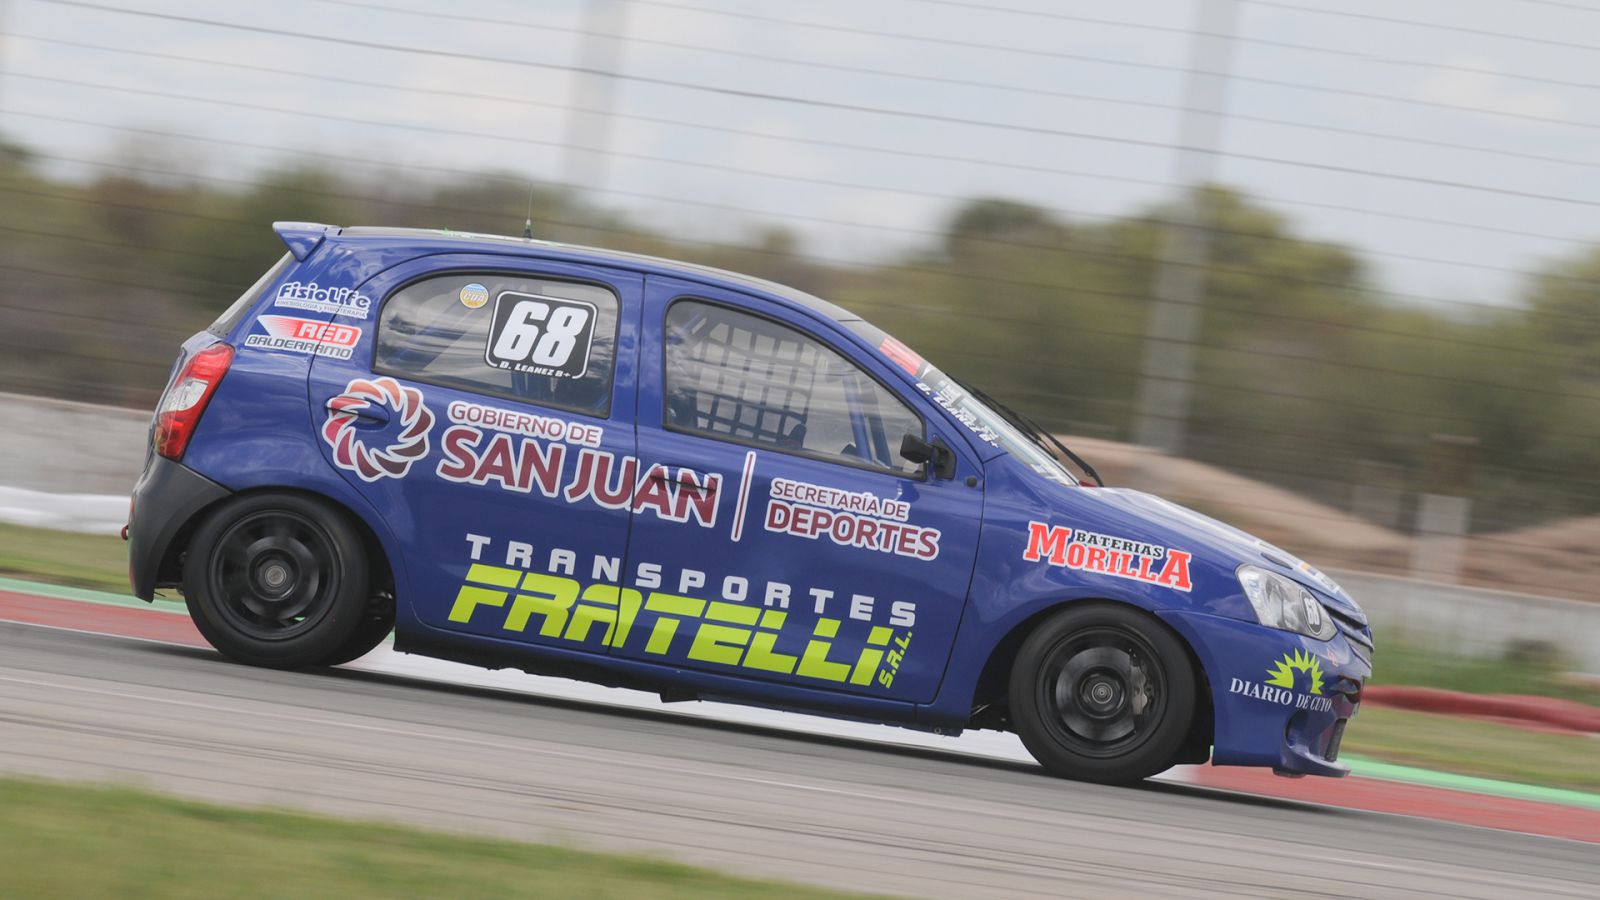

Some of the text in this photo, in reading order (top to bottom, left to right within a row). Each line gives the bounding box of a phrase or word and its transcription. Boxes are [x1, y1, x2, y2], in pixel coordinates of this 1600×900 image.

[247, 336, 351, 358] BALDERRAMO
[298, 322, 353, 343] RED
[493, 300, 589, 367] 68
[499, 361, 571, 378] D. LEANEZ B+
[451, 403, 600, 444] GOBIERNO DE
[440, 429, 719, 524] SAN JUAN
[773, 480, 907, 519] SECRETARÍA DE
[767, 503, 938, 557] DEPORTES
[1076, 531, 1162, 558] BATERIAS
[466, 533, 916, 627] TRANSPORTES
[878, 631, 913, 689] S.R.L.
[1229, 677, 1332, 712] DIARIO DE CUYO
